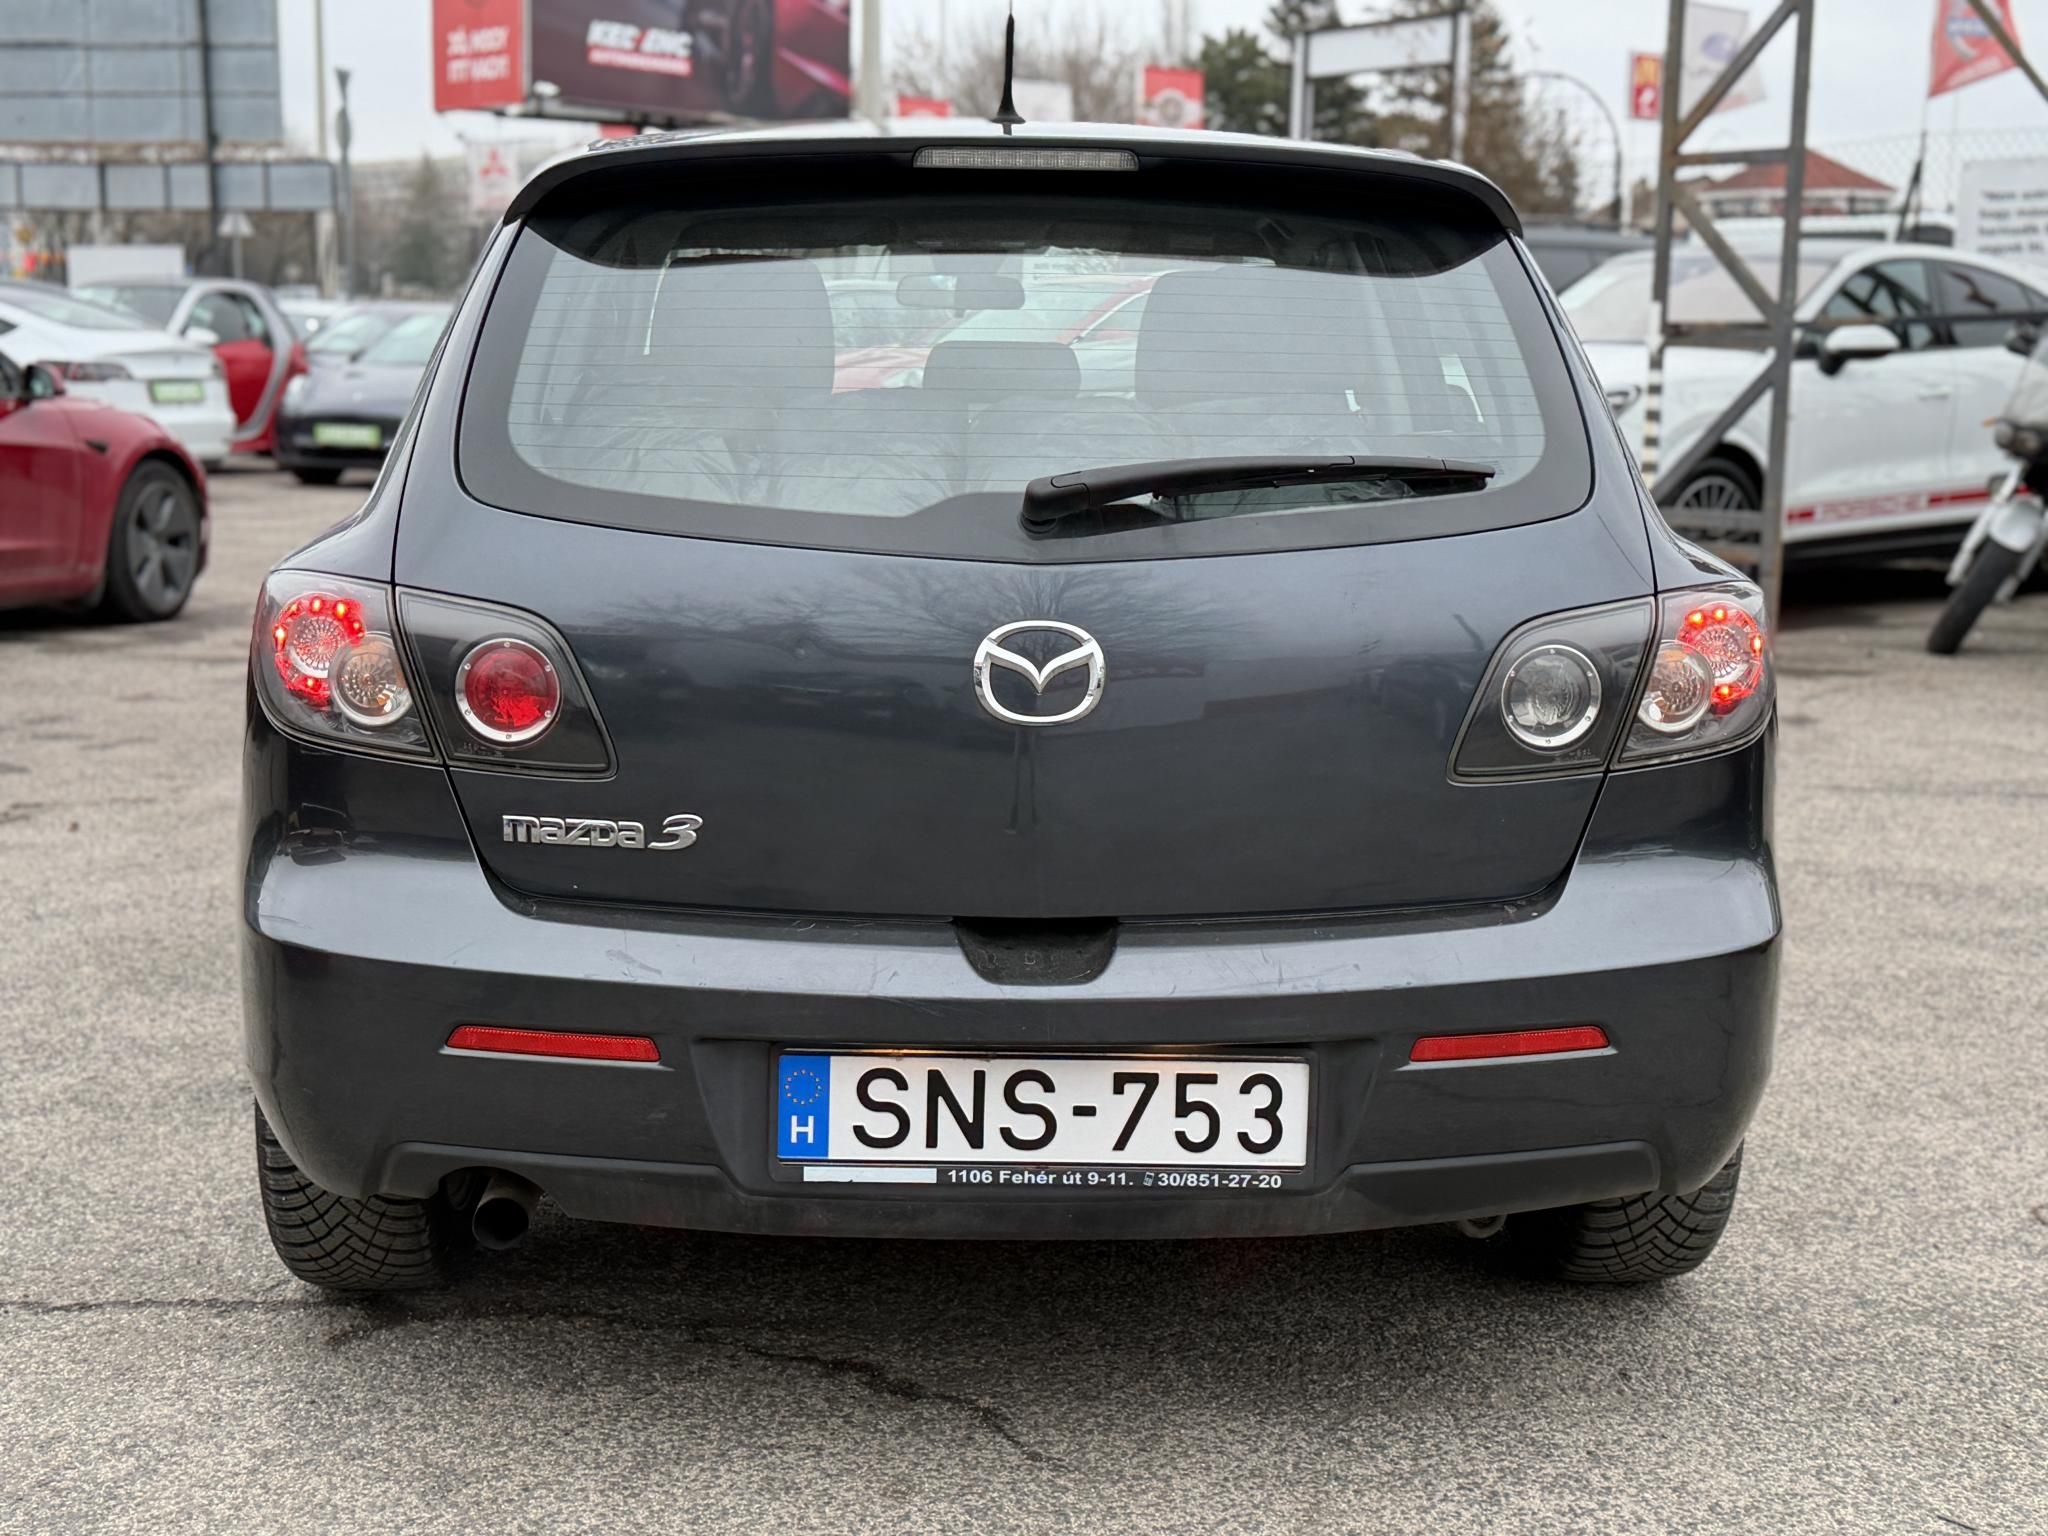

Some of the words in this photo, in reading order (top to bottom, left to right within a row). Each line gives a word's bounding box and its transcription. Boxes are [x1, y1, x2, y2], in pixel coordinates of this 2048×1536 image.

[502, 814, 645, 849] mazda
[648, 813, 703, 851] 3
[852, 1066, 1284, 1155] SNS-753
[790, 1115, 814, 1143] H
[948, 1170, 993, 1184] 1106
[999, 1169, 1057, 1185] Fehér
[1062, 1170, 1082, 1186] út
[1087, 1171, 1134, 1186] 9-11.
[1157, 1172, 1283, 1188] 30/851-27-20
